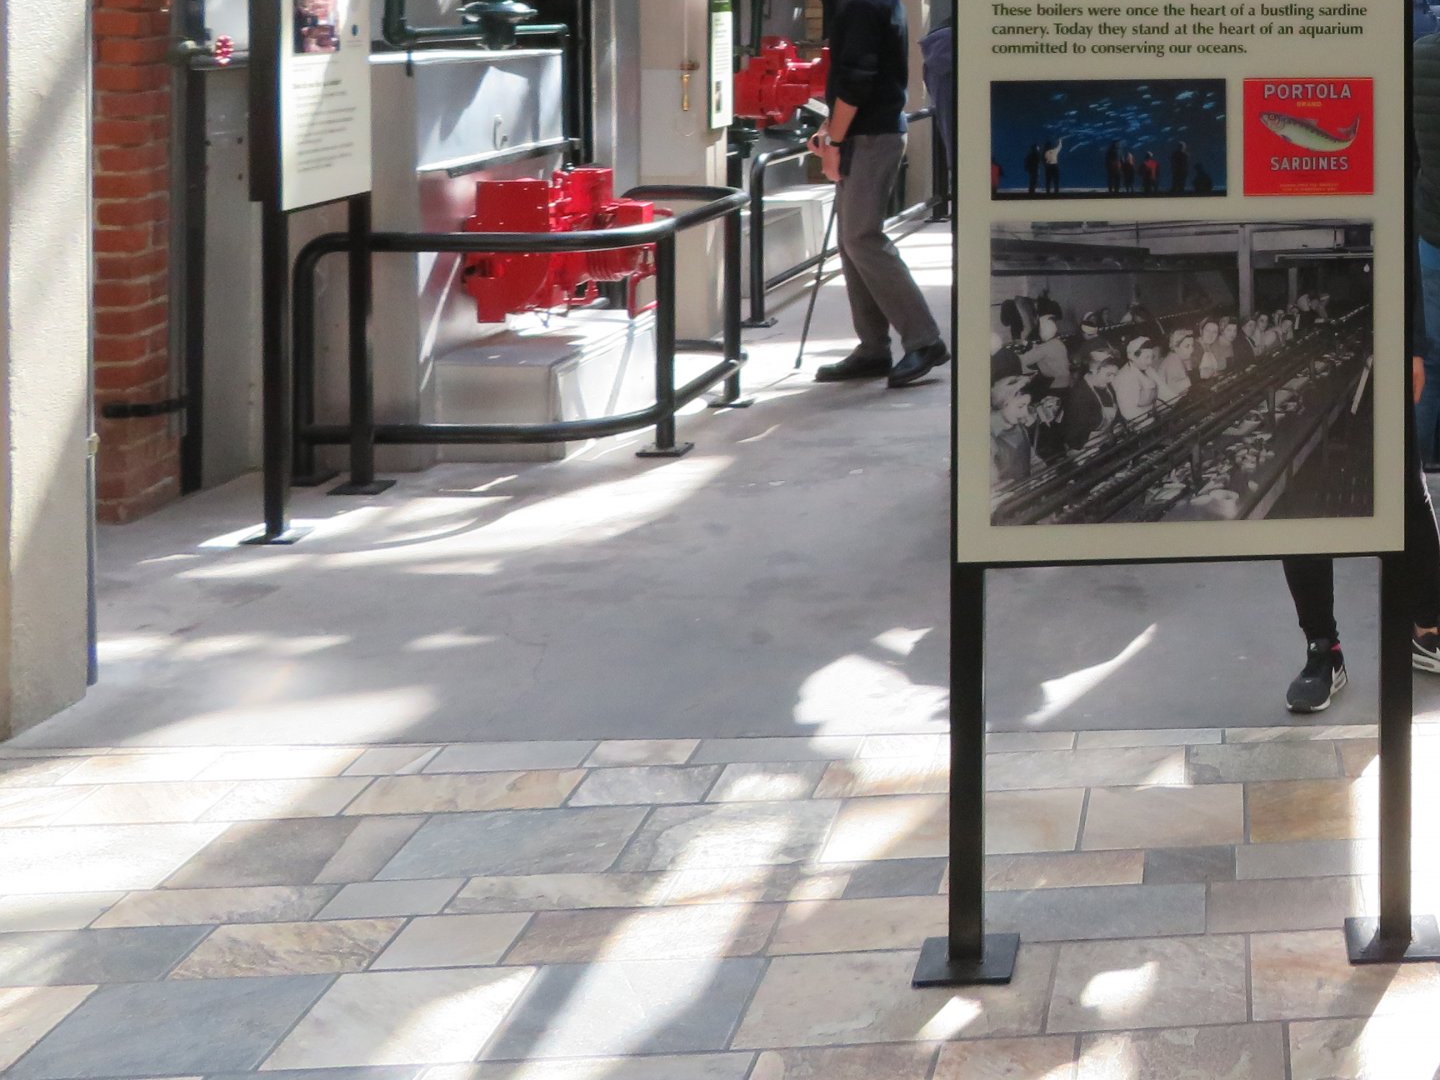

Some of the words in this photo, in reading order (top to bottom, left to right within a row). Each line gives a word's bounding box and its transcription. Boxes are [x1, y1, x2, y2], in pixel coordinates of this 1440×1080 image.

[992, 4, 1032, 17] These
[1035, 4, 1084, 17] boilers
[1086, 7, 1121, 17] were
[1124, 7, 1159, 17] once
[1162, 4, 1185, 17] the
[1188, 4, 1226, 17] heart
[1228, 4, 1244, 17] of
[1246, 7, 1256, 17] a
[1259, 4, 1315, 20] bustling
[1317, 4, 1368, 17] sardine
[990, 26, 1050, 38] cannery.
[1054, 22, 1093, 38] Today
[1096, 22, 1127, 38] they
[1130, 22, 1170, 35] stand
[1173, 24, 1187, 35] at
[1191, 22, 1214, 35] the
[1217, 22, 1255, 35] heart
[1258, 22, 1273, 35] of
[1276, 26, 1294, 35] an
[1297, 22, 1364, 38] aquarium
[990, 41, 1068, 54] committed
[1071, 42, 1087, 54] to
[1089, 41, 1165, 57] conserving
[1167, 45, 1192, 54] our
[1195, 45, 1248, 54] oceans.
[1264, 83, 1352, 100] PORTOLA
[1270, 156, 1348, 171] SARDINES
